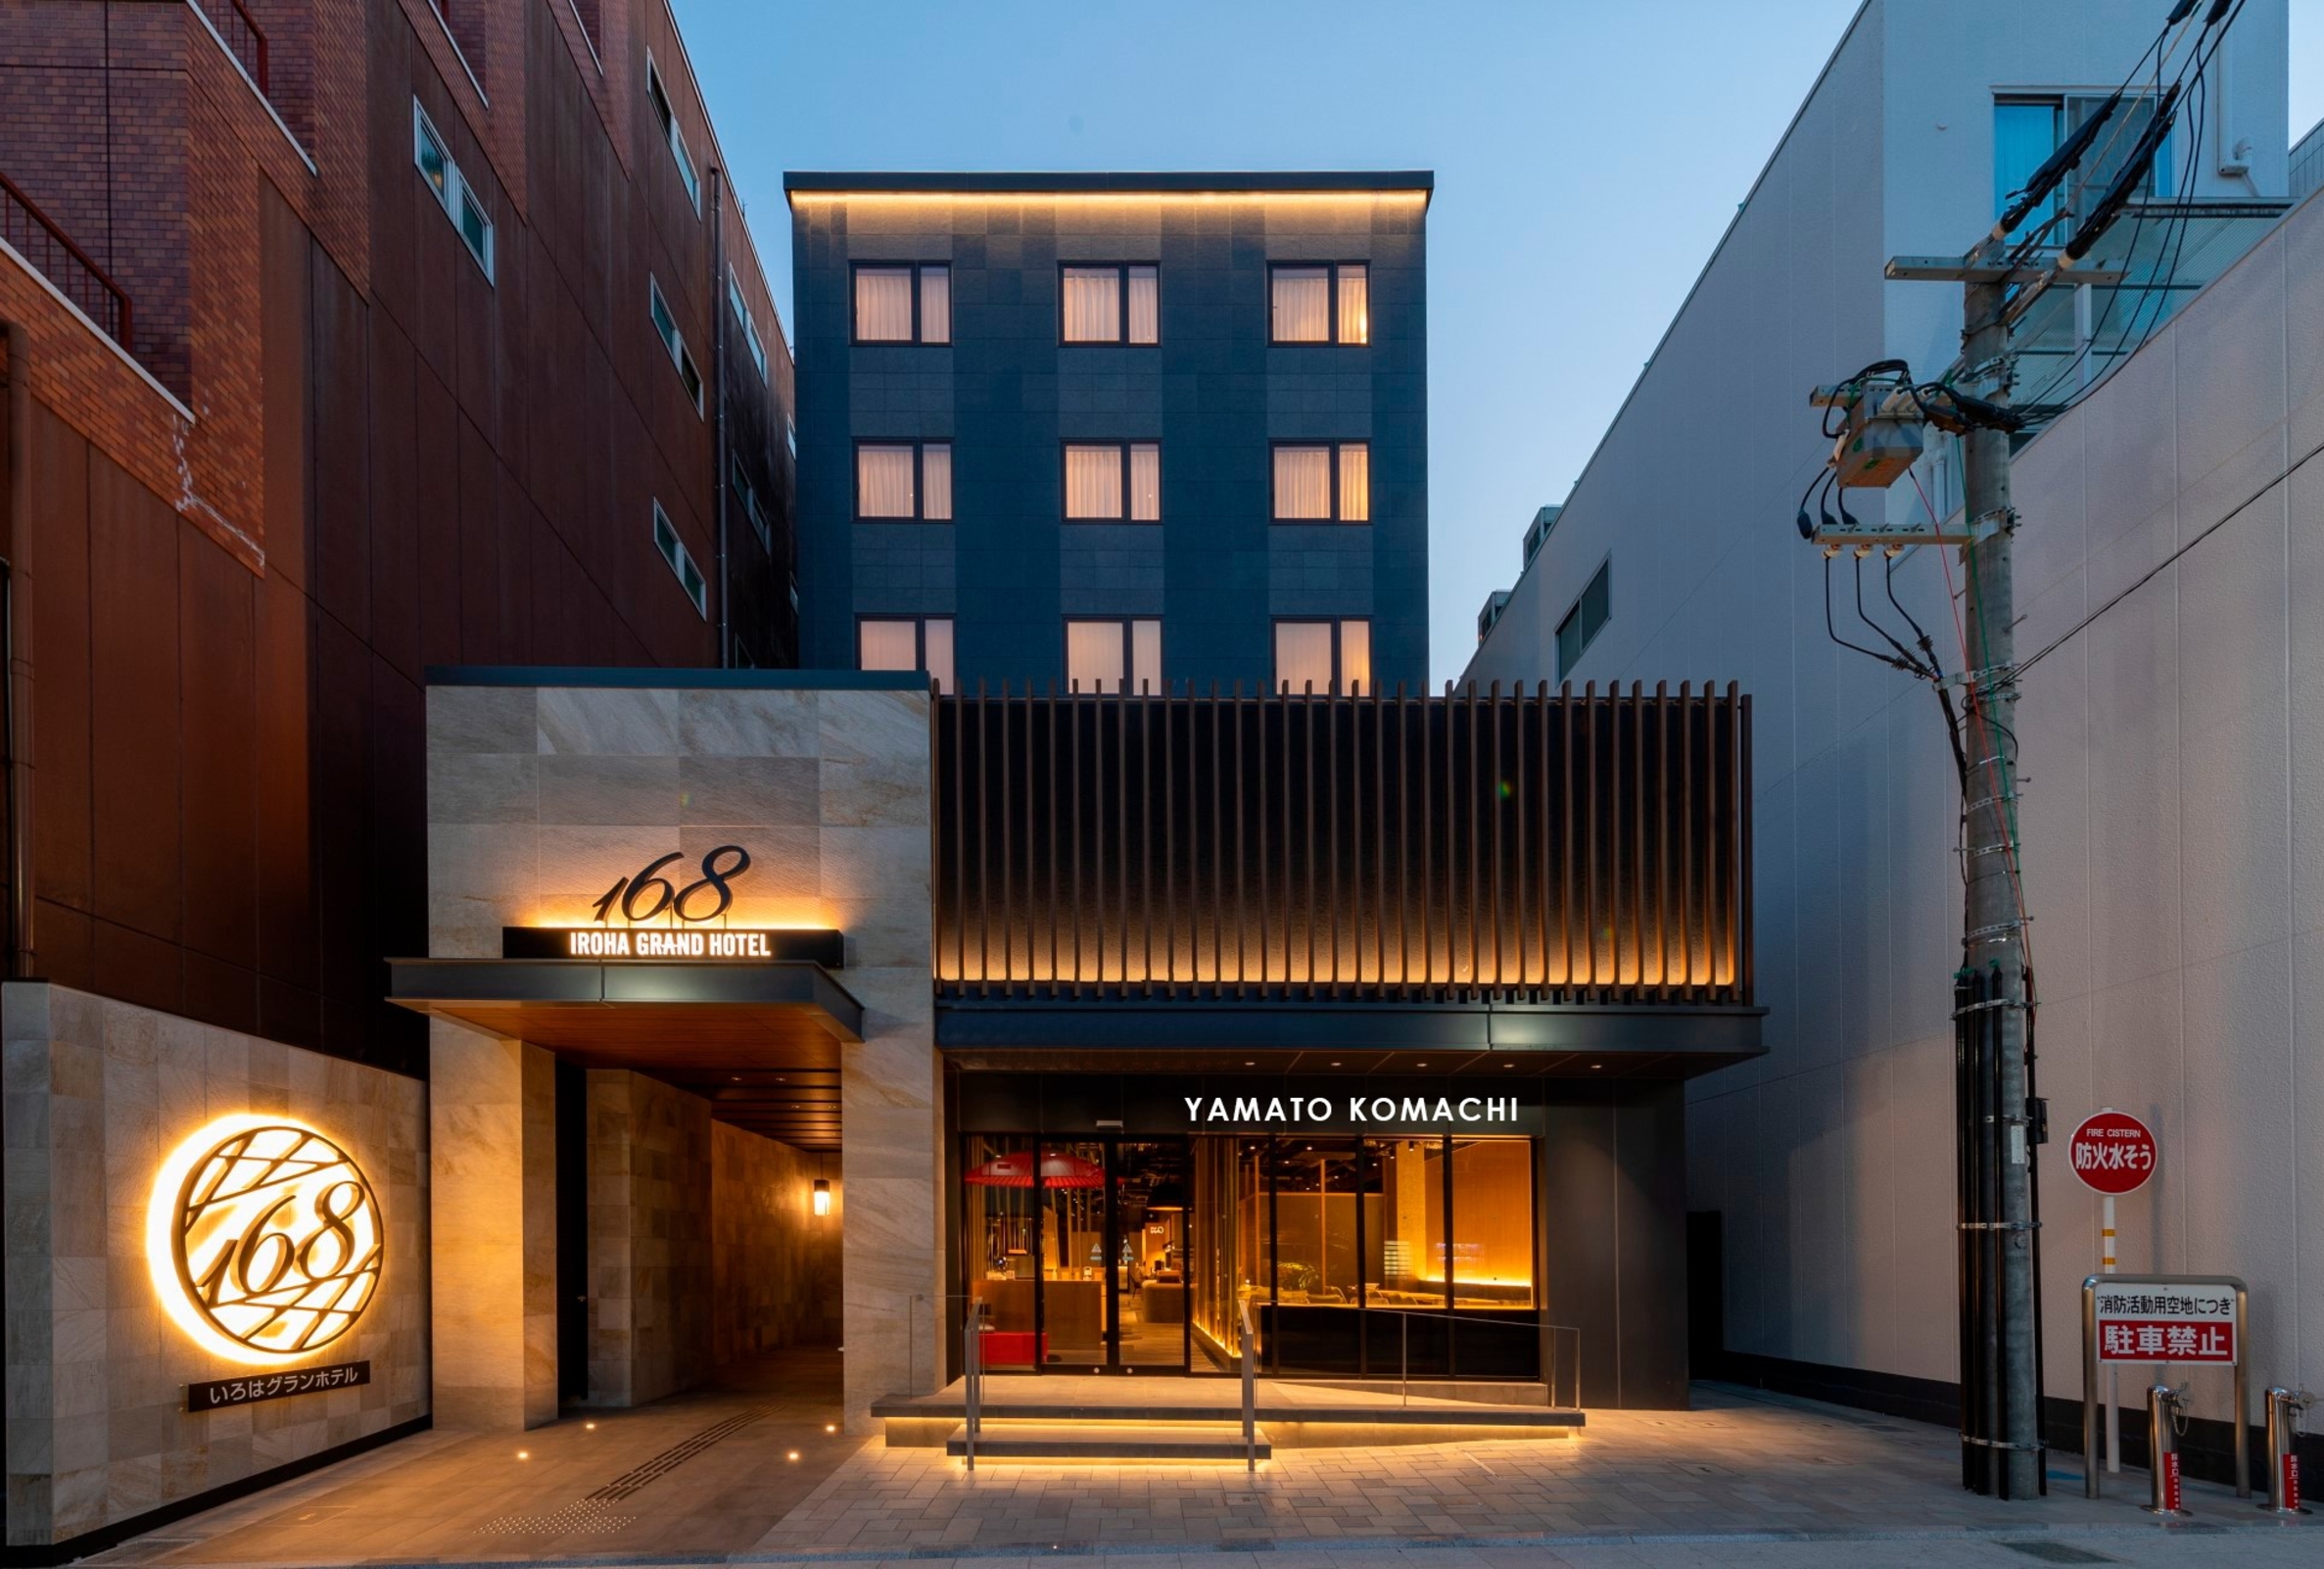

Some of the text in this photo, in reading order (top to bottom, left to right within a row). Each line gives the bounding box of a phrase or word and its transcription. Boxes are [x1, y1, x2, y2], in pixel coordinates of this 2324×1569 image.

[592, 845, 751, 922] 168
[570, 931, 772, 957] IROHA GRAND HOTEL
[1183, 1097, 1518, 1122] YAMATO KOMACHI
[2086, 1128, 2141, 1139] FIRE CISTERN
[2075, 1142, 2152, 1170] 防火水そう
[196, 1180, 365, 1309] 168
[2100, 1295, 2231, 1315] 消防活動用空地につき
[2105, 1325, 2228, 1356] 駐車禁止
[209, 1366, 358, 1404] いろはグランホテル
